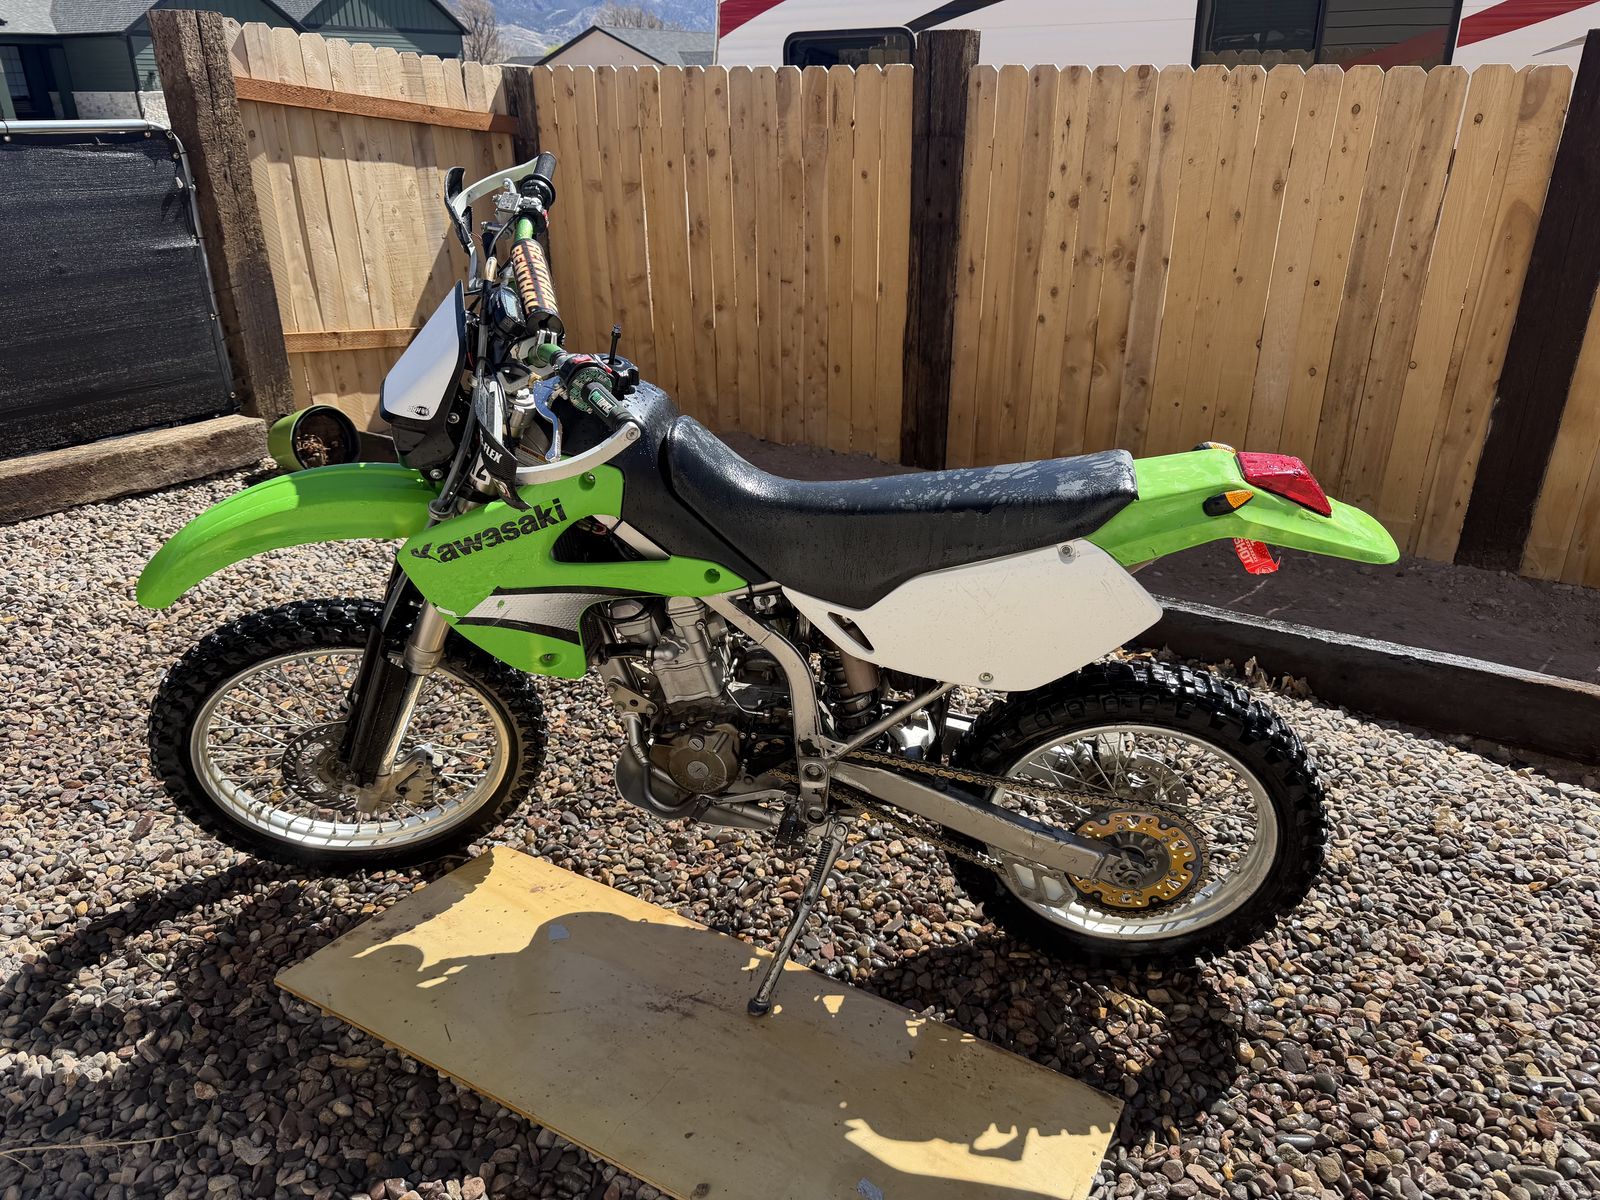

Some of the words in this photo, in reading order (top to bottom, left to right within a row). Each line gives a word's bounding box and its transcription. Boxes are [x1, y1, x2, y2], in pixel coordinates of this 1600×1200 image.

[511, 244, 541, 315] RENTHAL
[525, 240, 559, 314] RENTHAL
[410, 498, 567, 563] Kawasaki
